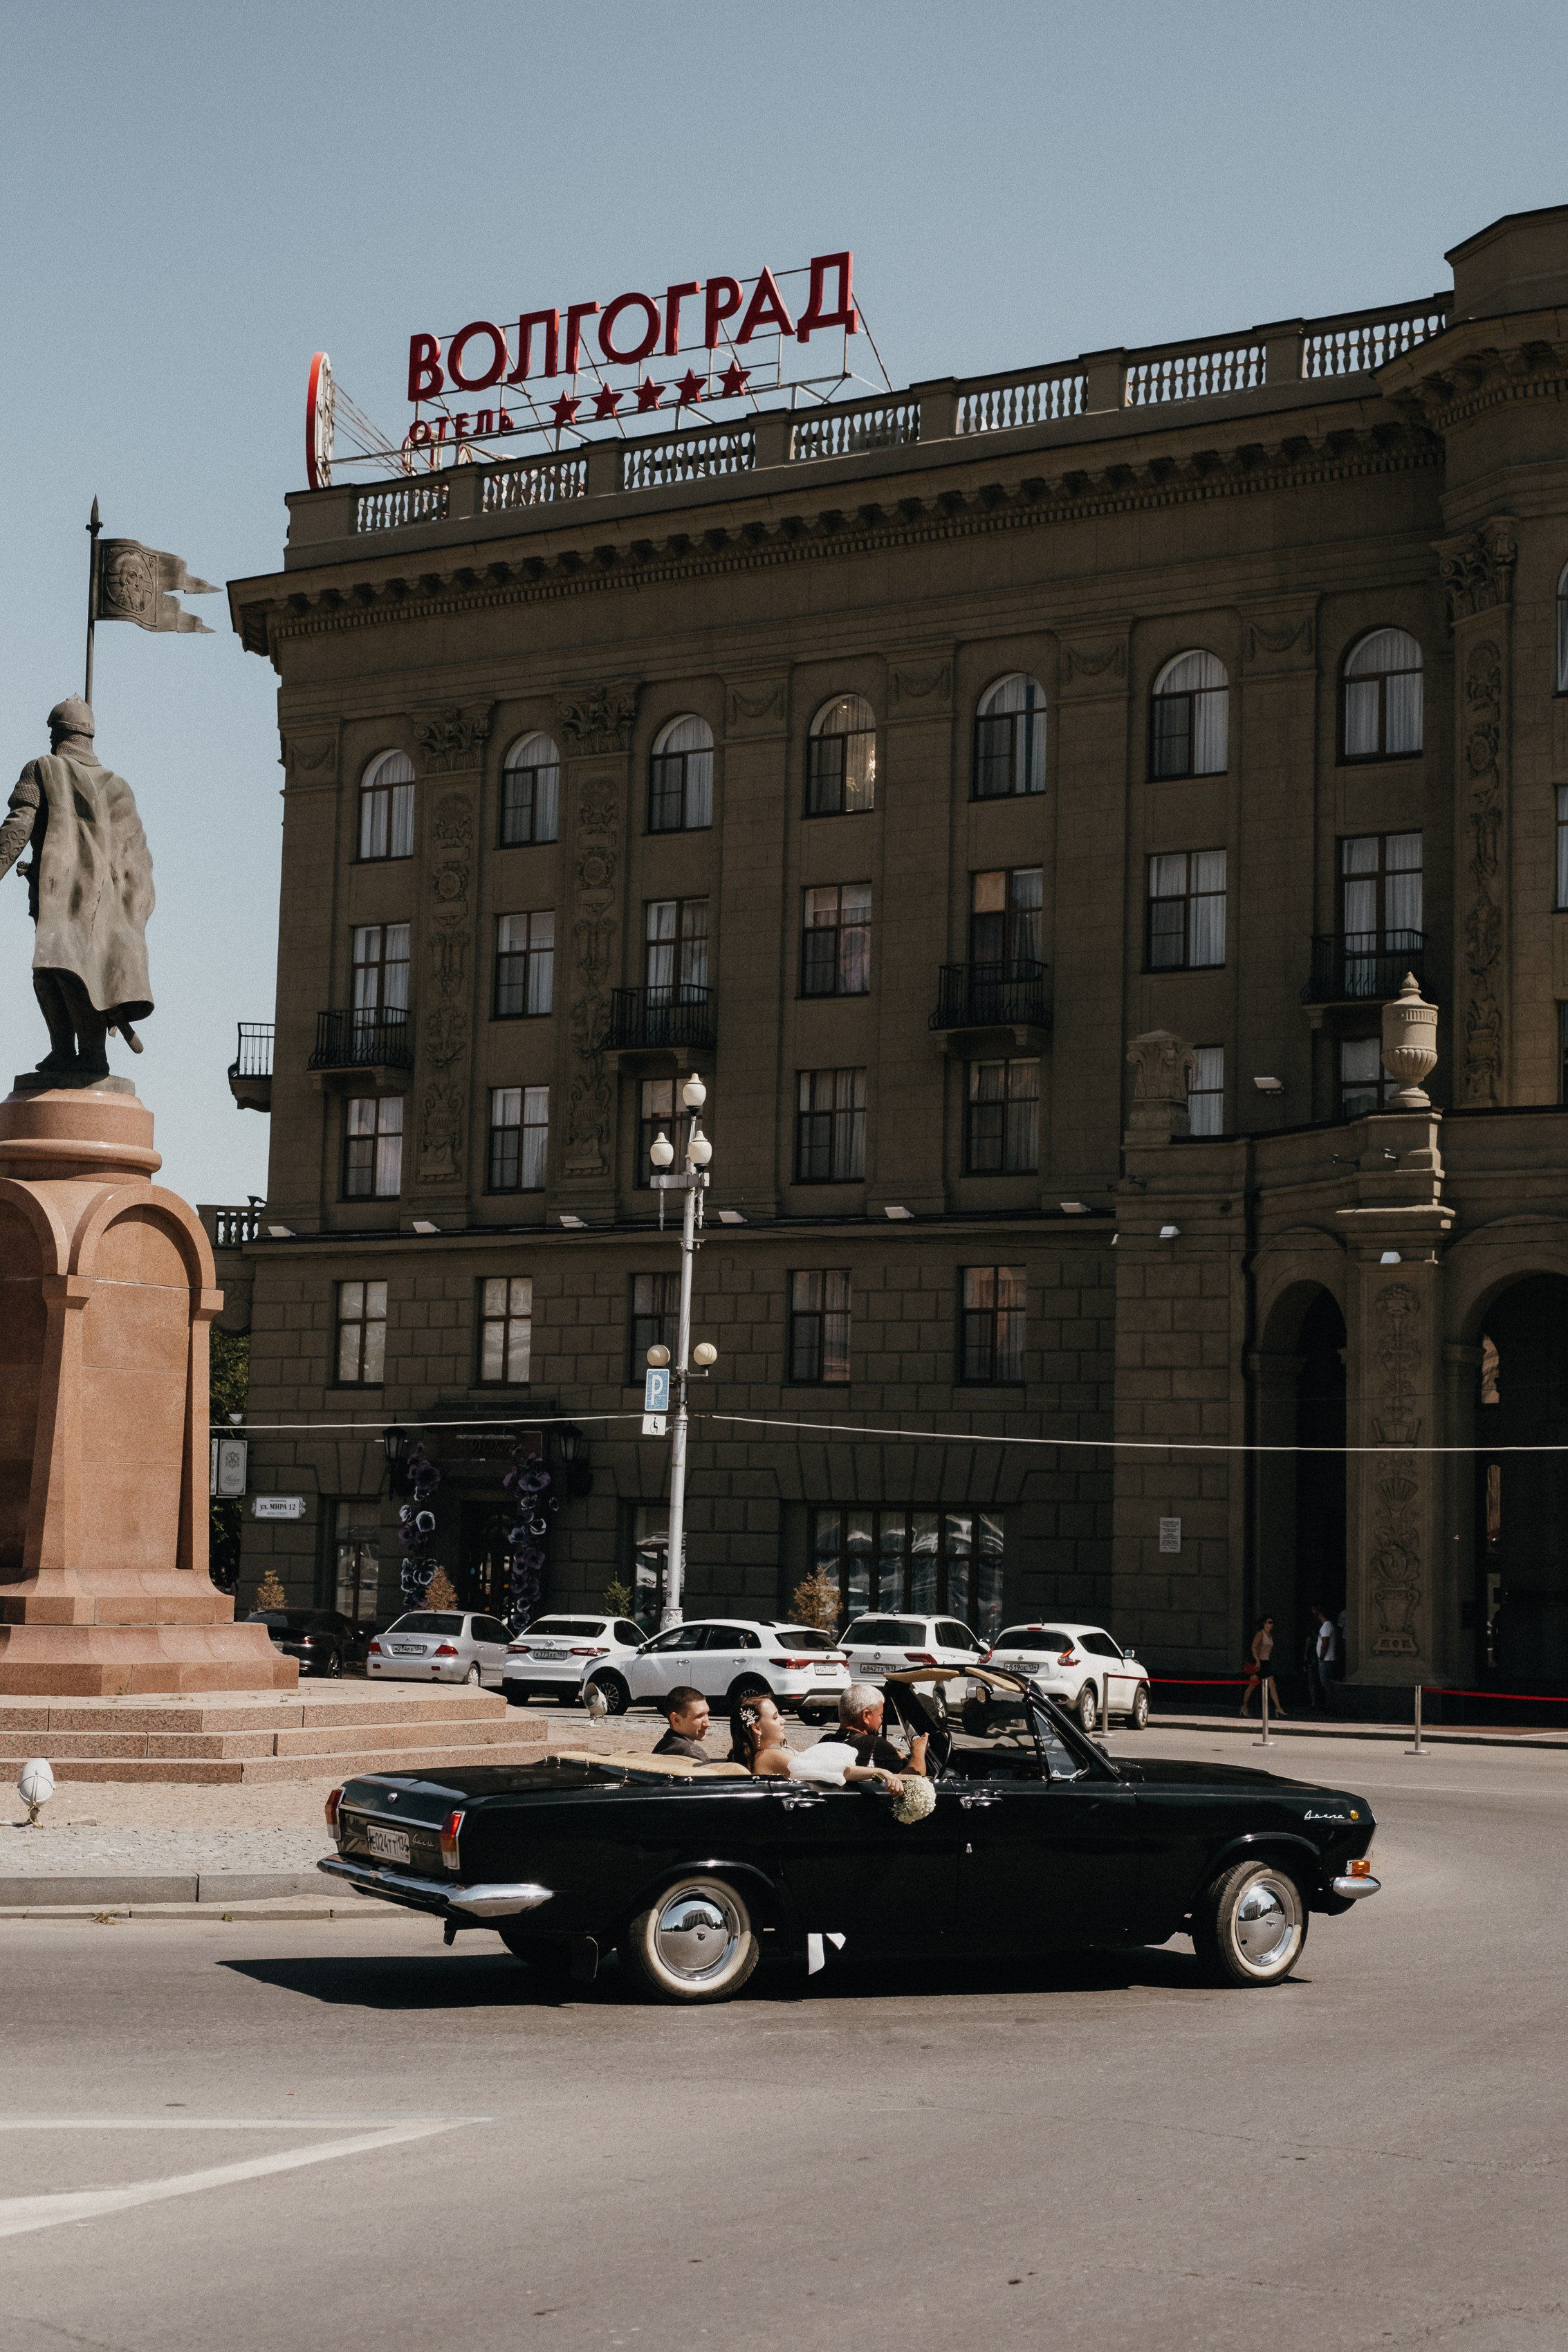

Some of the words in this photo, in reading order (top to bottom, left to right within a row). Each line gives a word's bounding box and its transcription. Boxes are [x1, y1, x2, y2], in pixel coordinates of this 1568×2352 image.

[408, 251, 858, 402] ВОЛГОГРАД
[409, 407, 514, 445] ОТЕЛЬ
[651, 1375, 663, 1406] P
